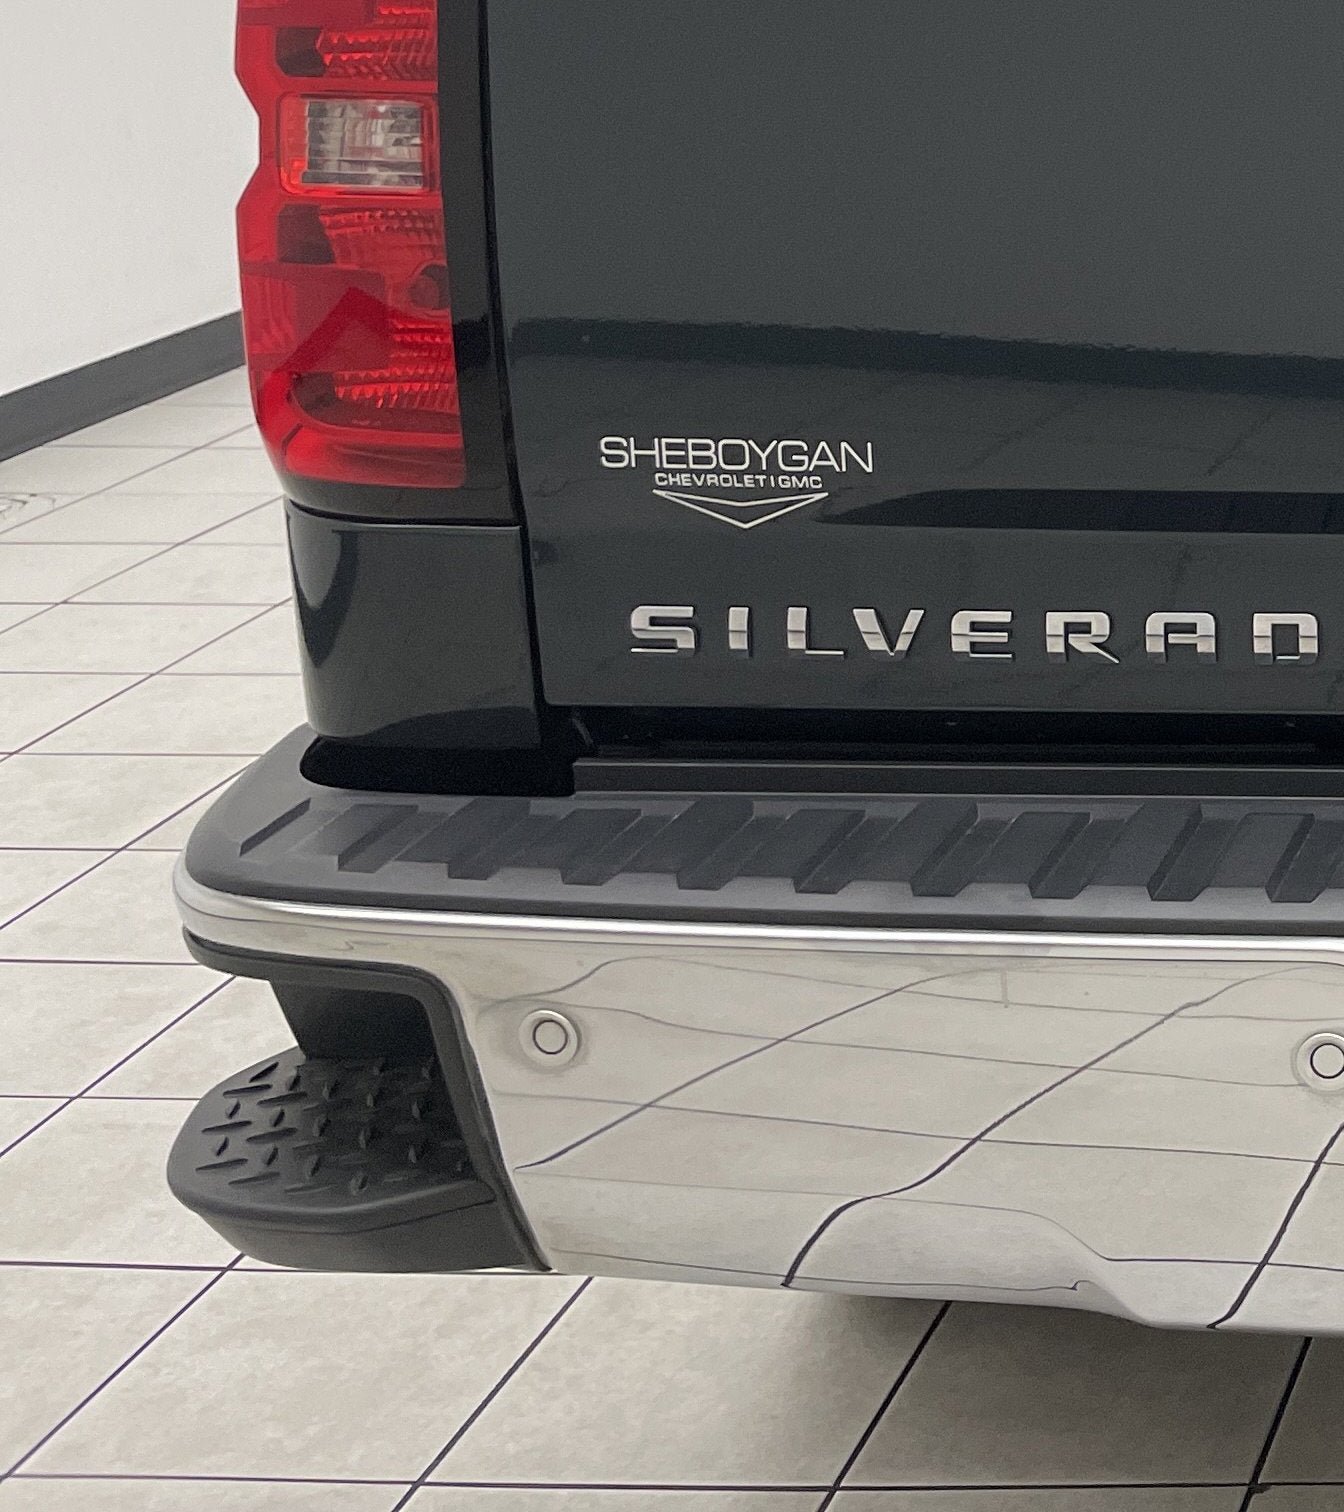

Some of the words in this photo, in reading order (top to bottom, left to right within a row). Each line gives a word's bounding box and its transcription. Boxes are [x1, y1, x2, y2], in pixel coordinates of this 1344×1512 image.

[600, 436, 873, 473] SHEBOYGAN
[655, 473, 767, 488] CHEVROLET
[778, 475, 823, 488] GMC
